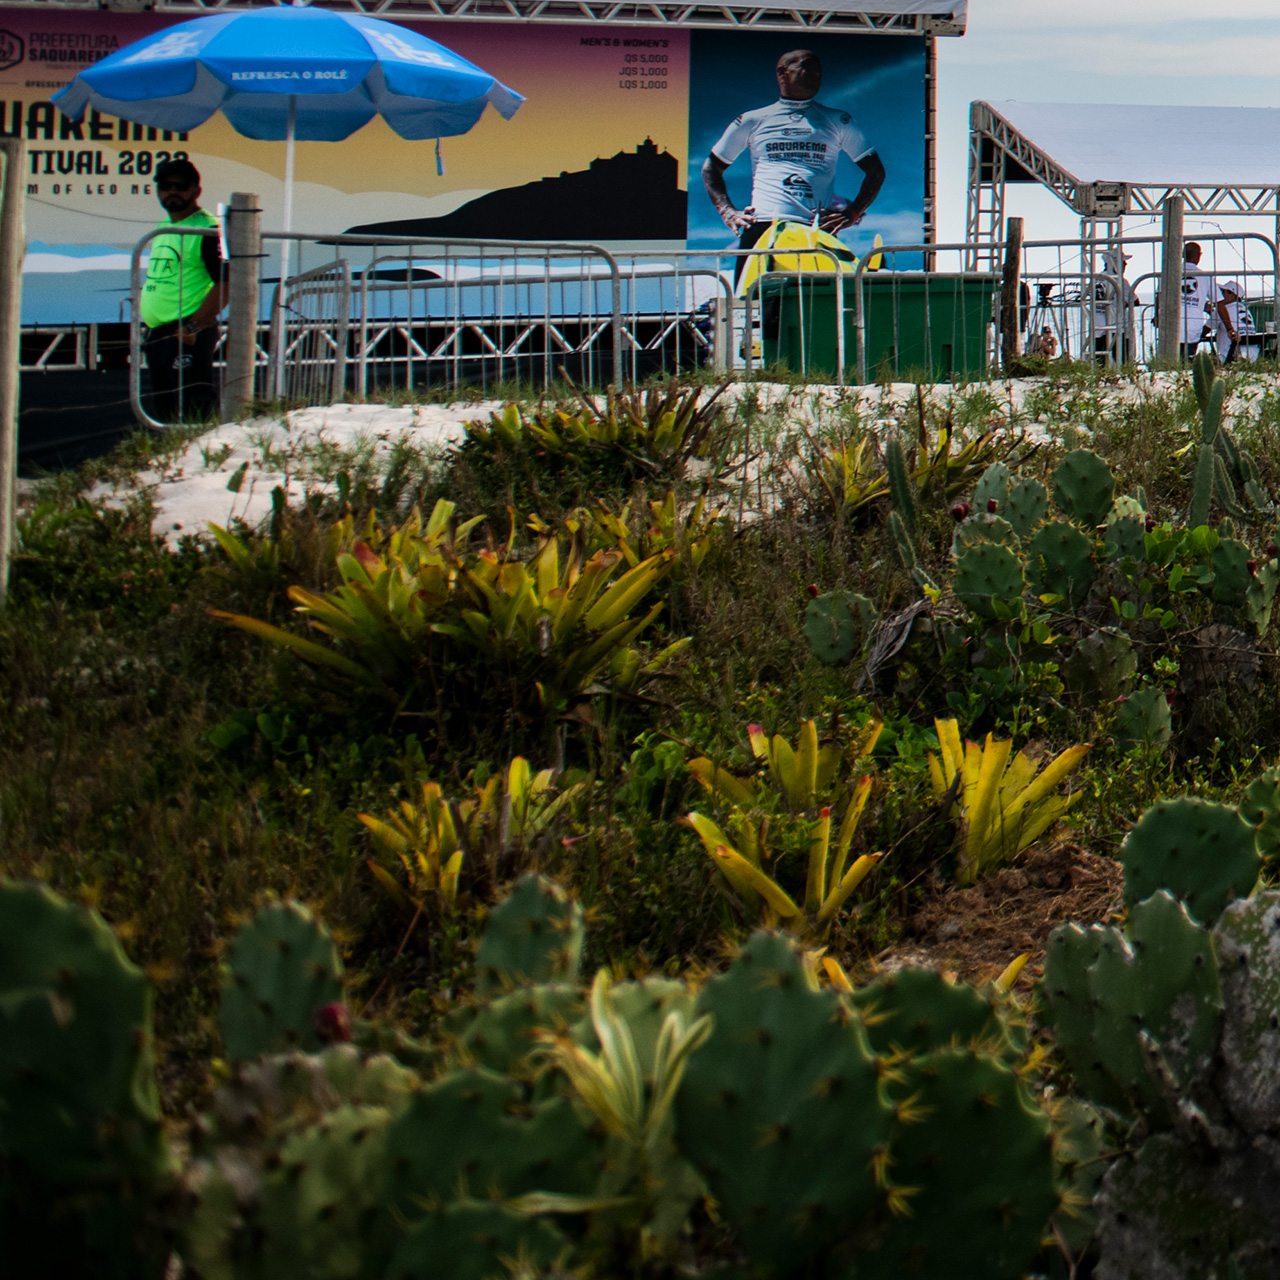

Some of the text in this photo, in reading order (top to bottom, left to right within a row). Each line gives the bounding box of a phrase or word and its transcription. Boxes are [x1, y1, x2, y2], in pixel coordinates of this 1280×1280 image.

[29, 32, 119, 49] PREFEITURA
[28, 48, 116, 63] SAQUAREM
[625, 54, 668, 64] QS 5,000
[232, 69, 347, 80] REFRESCA O ROLÊ
[619, 67, 668, 77] JQS 1,000
[619, 80, 668, 90] LQS 1,000
[766, 141, 828, 152] SAQUAREMA
[53, 184, 73, 195] OF
[86, 184, 118, 195] LEO
